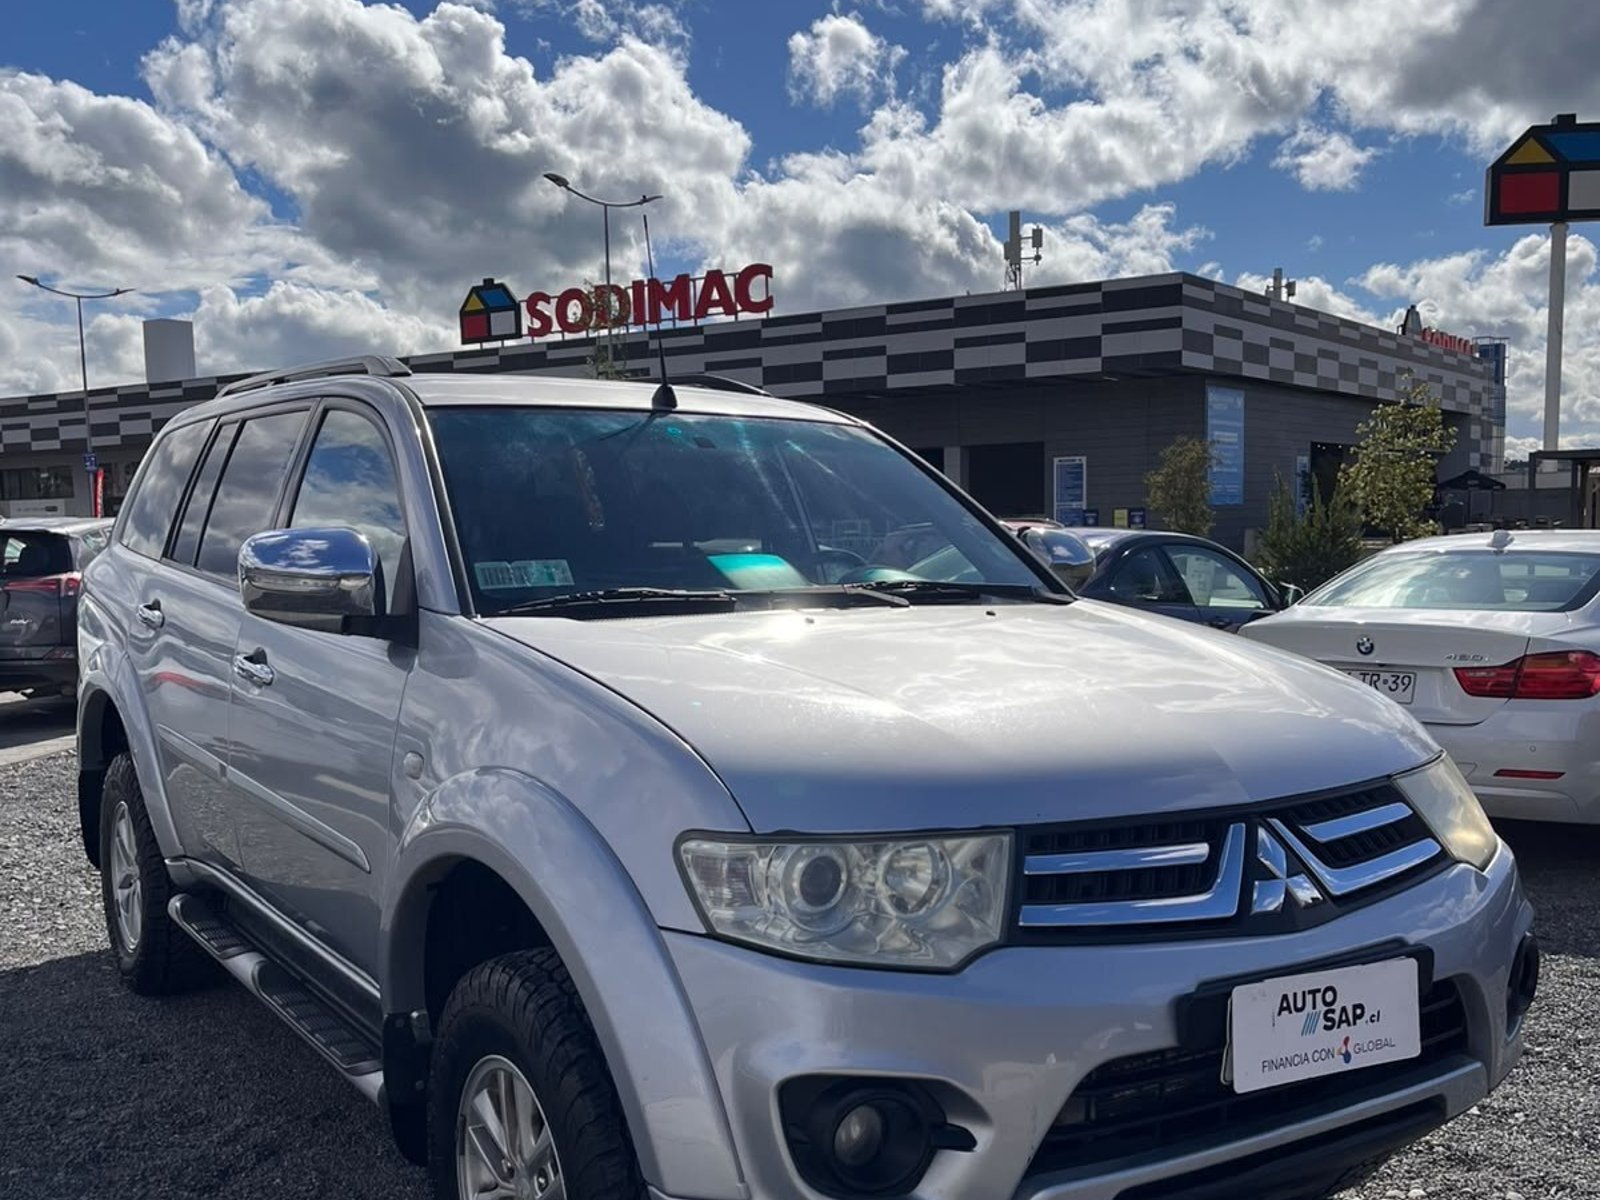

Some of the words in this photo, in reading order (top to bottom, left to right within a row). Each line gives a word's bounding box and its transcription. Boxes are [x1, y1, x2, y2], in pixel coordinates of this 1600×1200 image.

[526, 263, 774, 337] SODIMAC
[1277, 985, 1337, 1016] AUTO
[1261, 1052, 1310, 1073] FINANCIA
[1311, 1047, 1335, 1063] CON
[1353, 1037, 1396, 1054] GLOBAL
